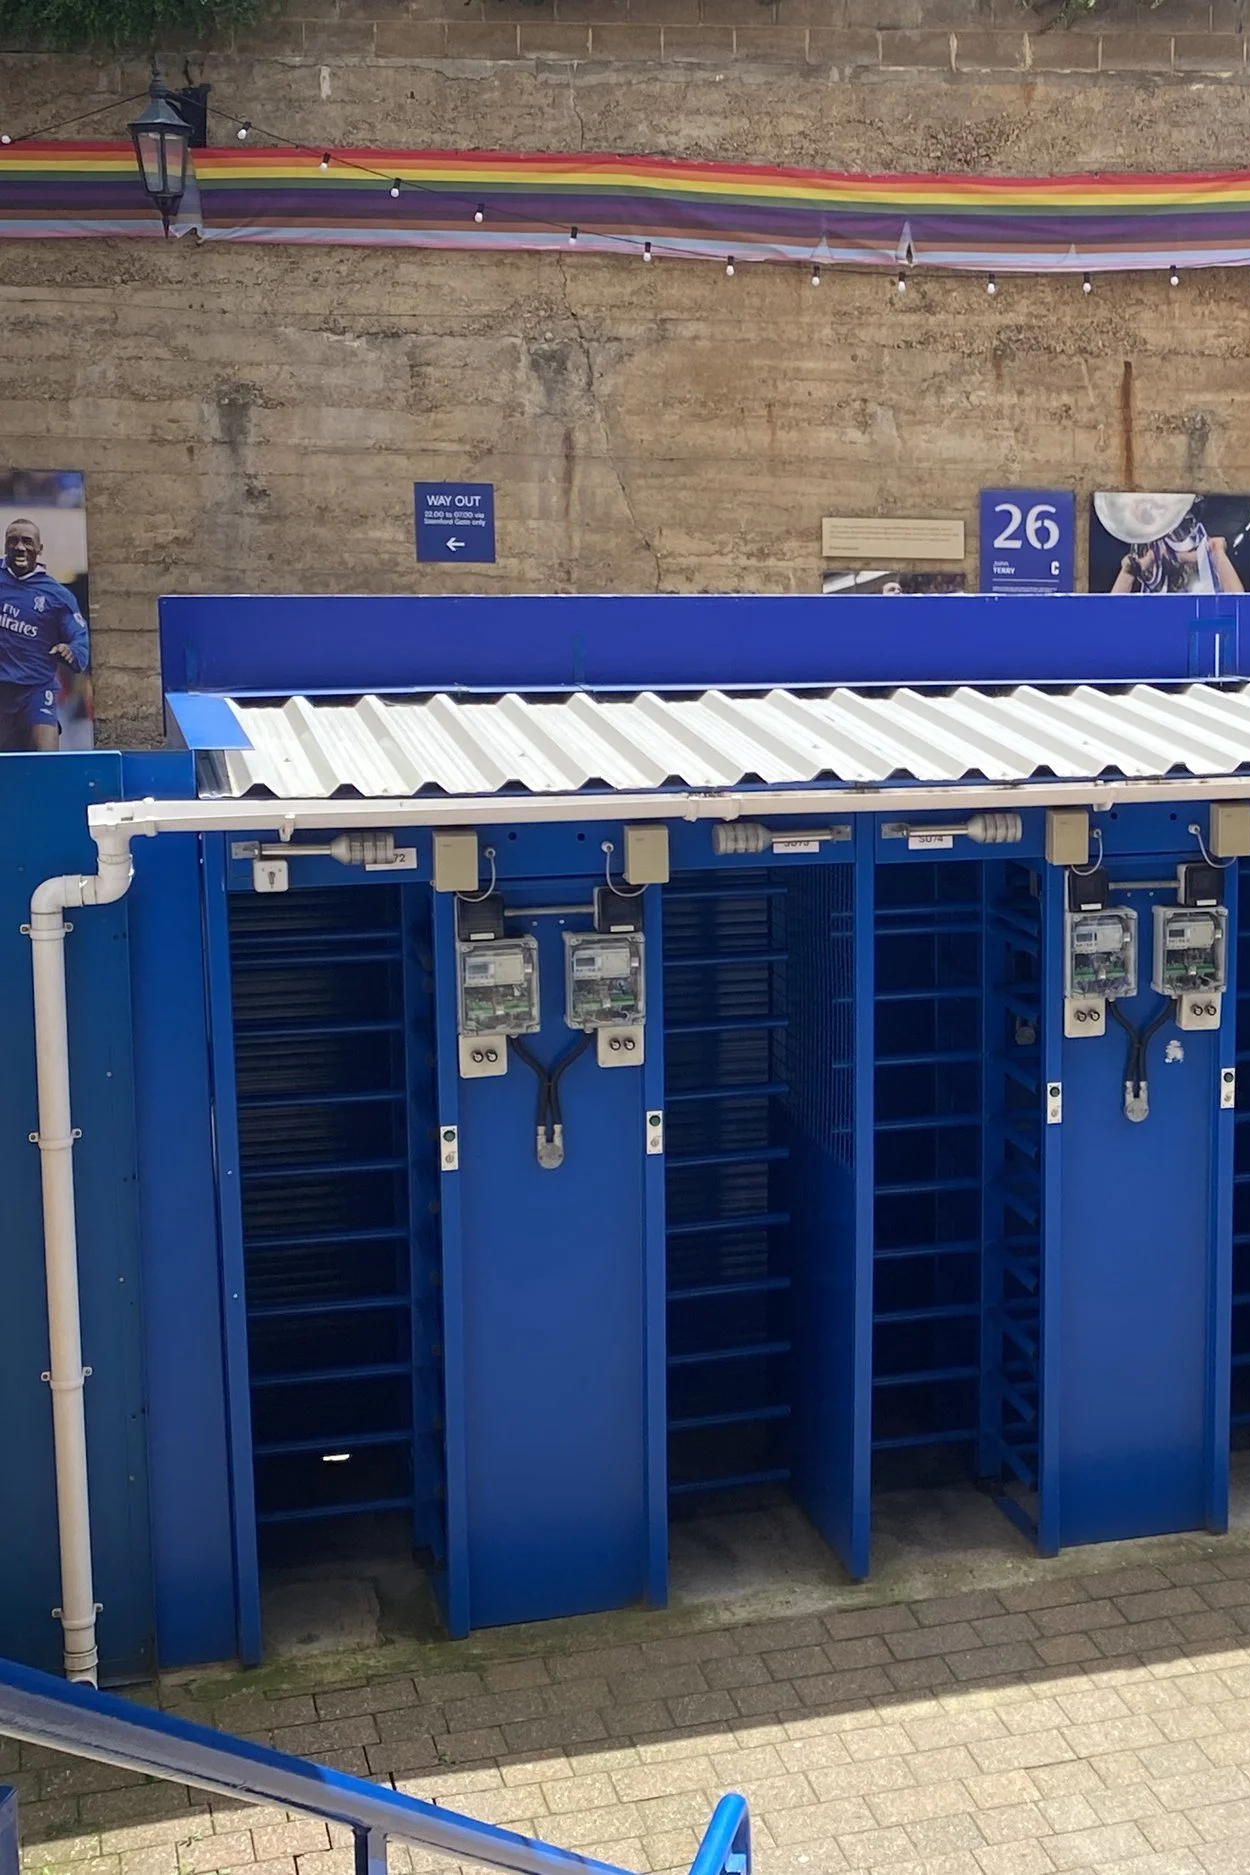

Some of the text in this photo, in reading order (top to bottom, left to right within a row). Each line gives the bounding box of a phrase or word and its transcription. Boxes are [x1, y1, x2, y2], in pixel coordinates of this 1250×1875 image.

[426, 495, 481, 507] WAY OUT
[993, 503, 1060, 550] 26
[993, 567, 1015, 575] TERRY
[1051, 561, 1060, 576] C
[44, 690, 54, 706] 9
